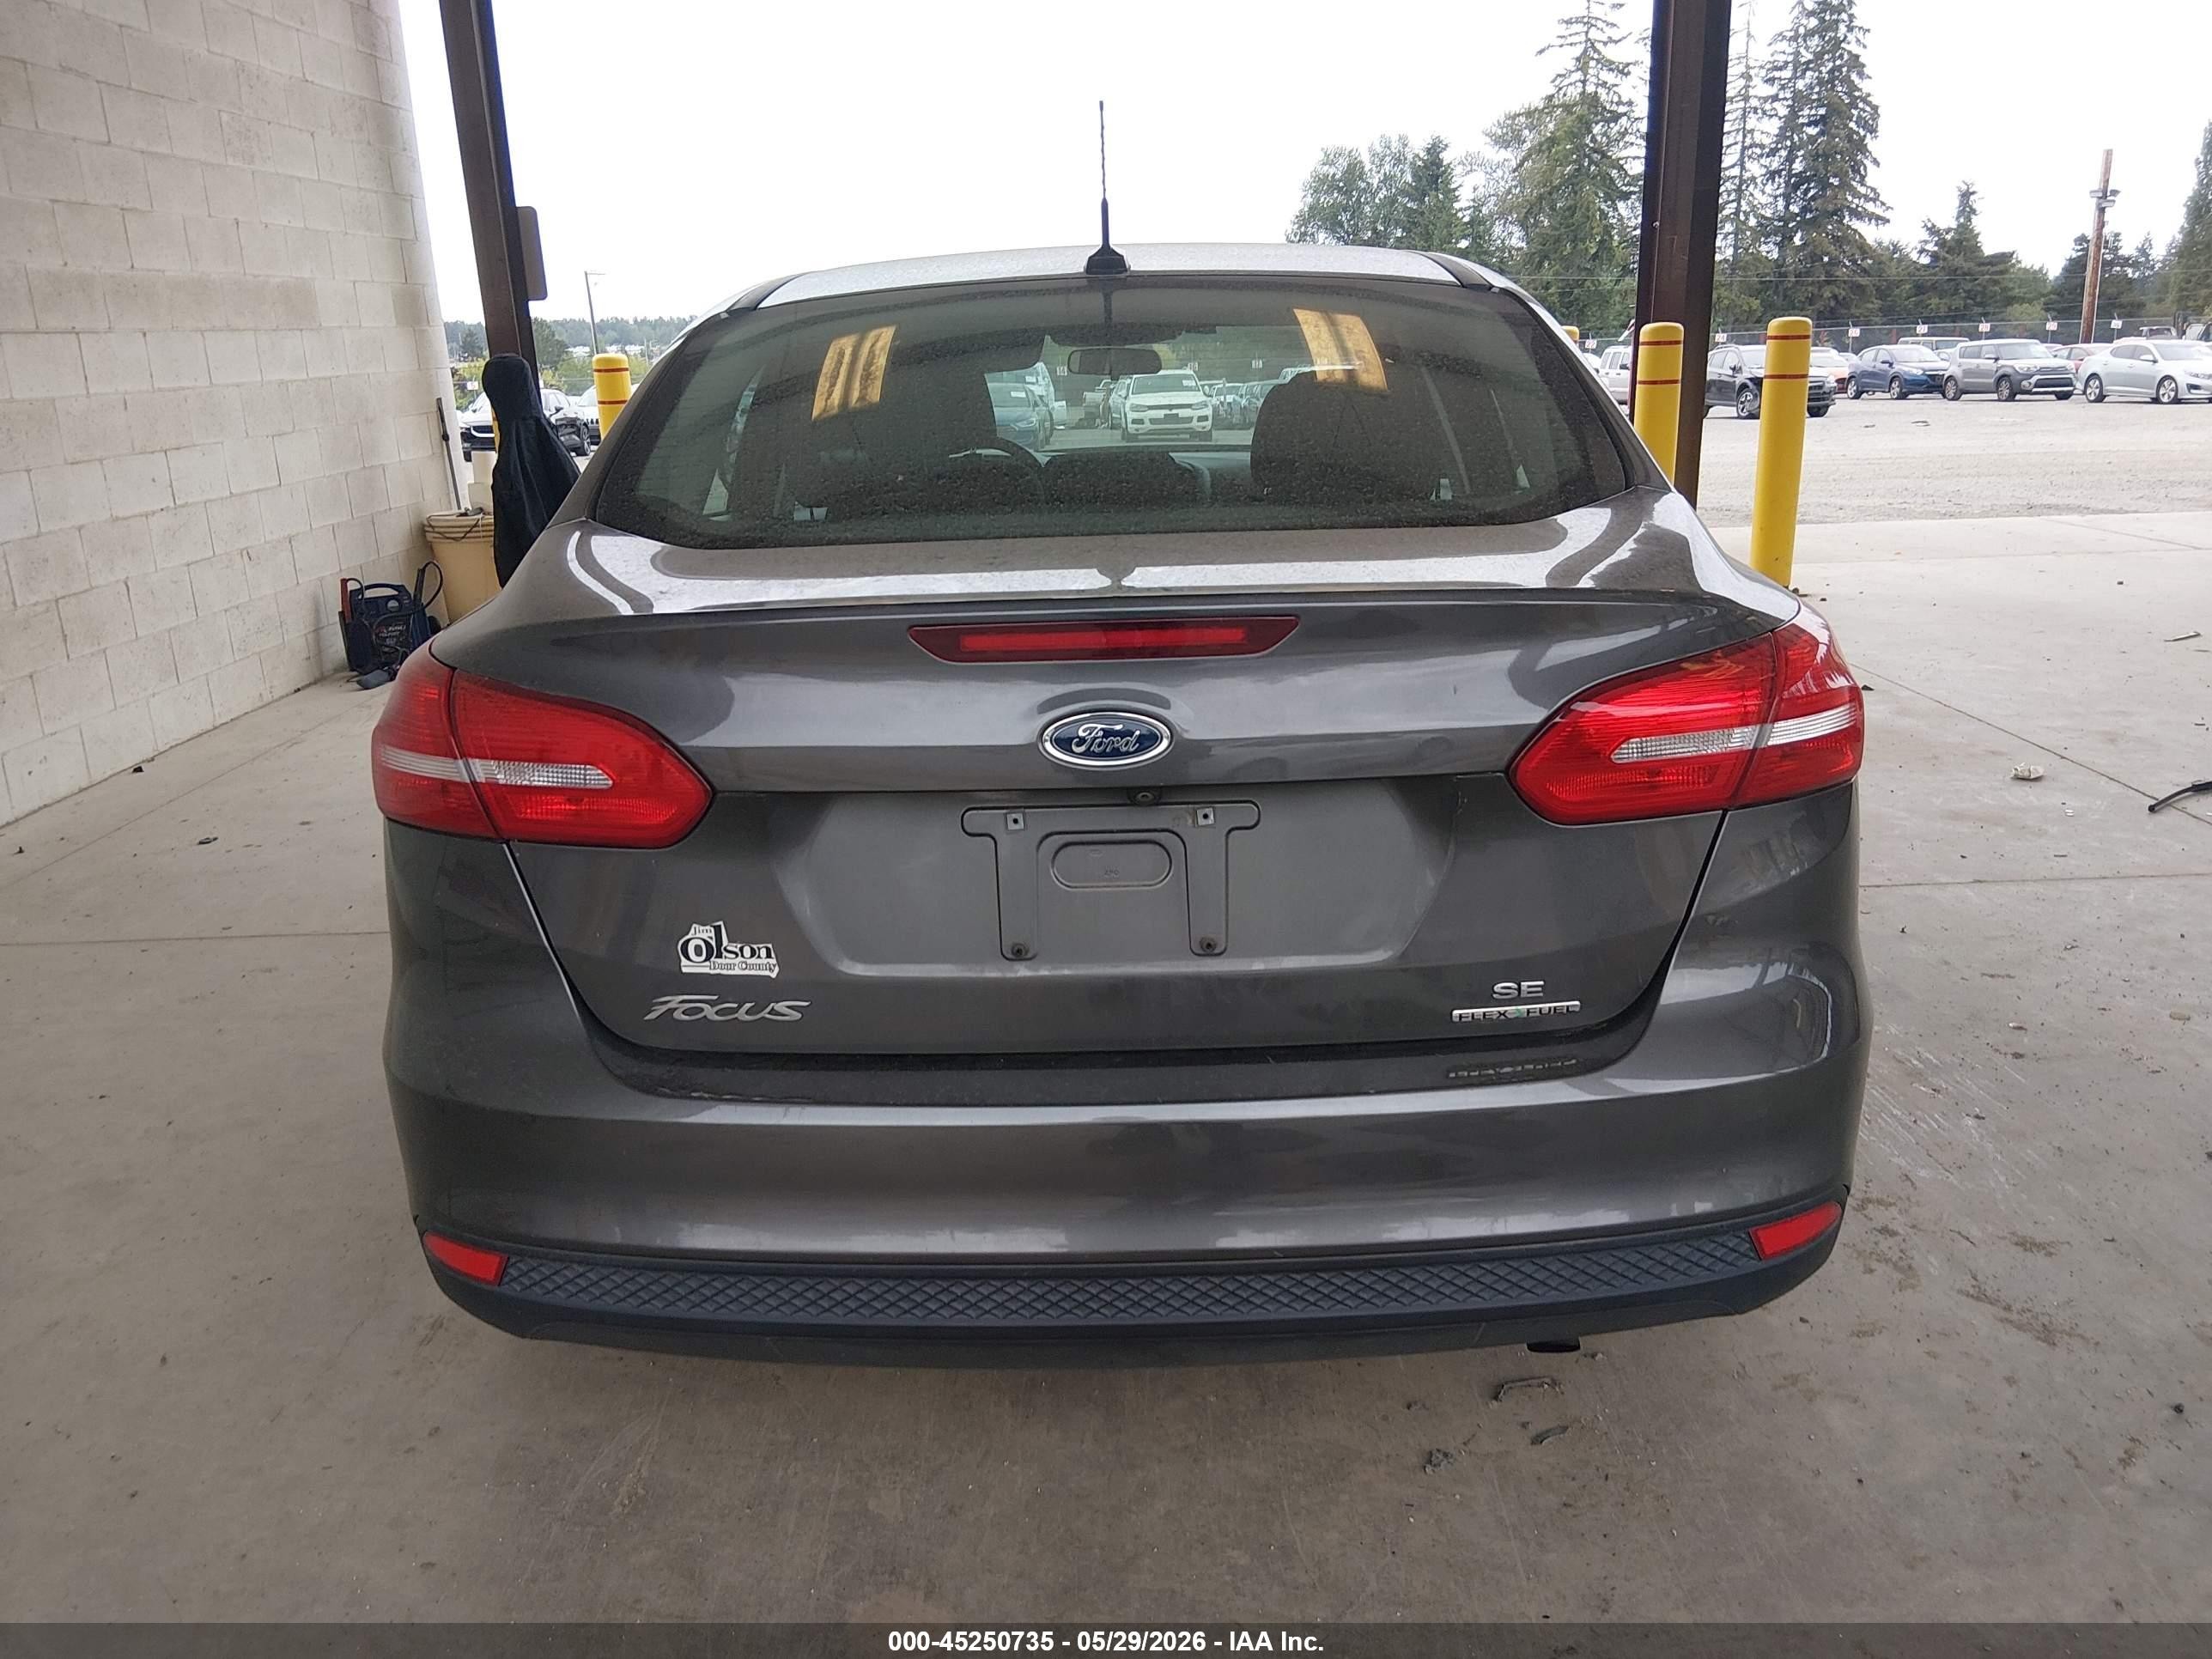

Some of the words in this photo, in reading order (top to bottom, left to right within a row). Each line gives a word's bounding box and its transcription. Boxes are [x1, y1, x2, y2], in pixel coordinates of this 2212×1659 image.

[1071, 723, 1141, 754] Ford
[691, 926, 713, 936] Jim
[680, 923, 775, 963] Olson
[709, 961, 737, 971] Door
[738, 961, 777, 973] County
[1492, 980, 1545, 1000] SE
[1459, 1011, 1510, 1023] FLEX
[1527, 1004, 1569, 1018] FUEL
